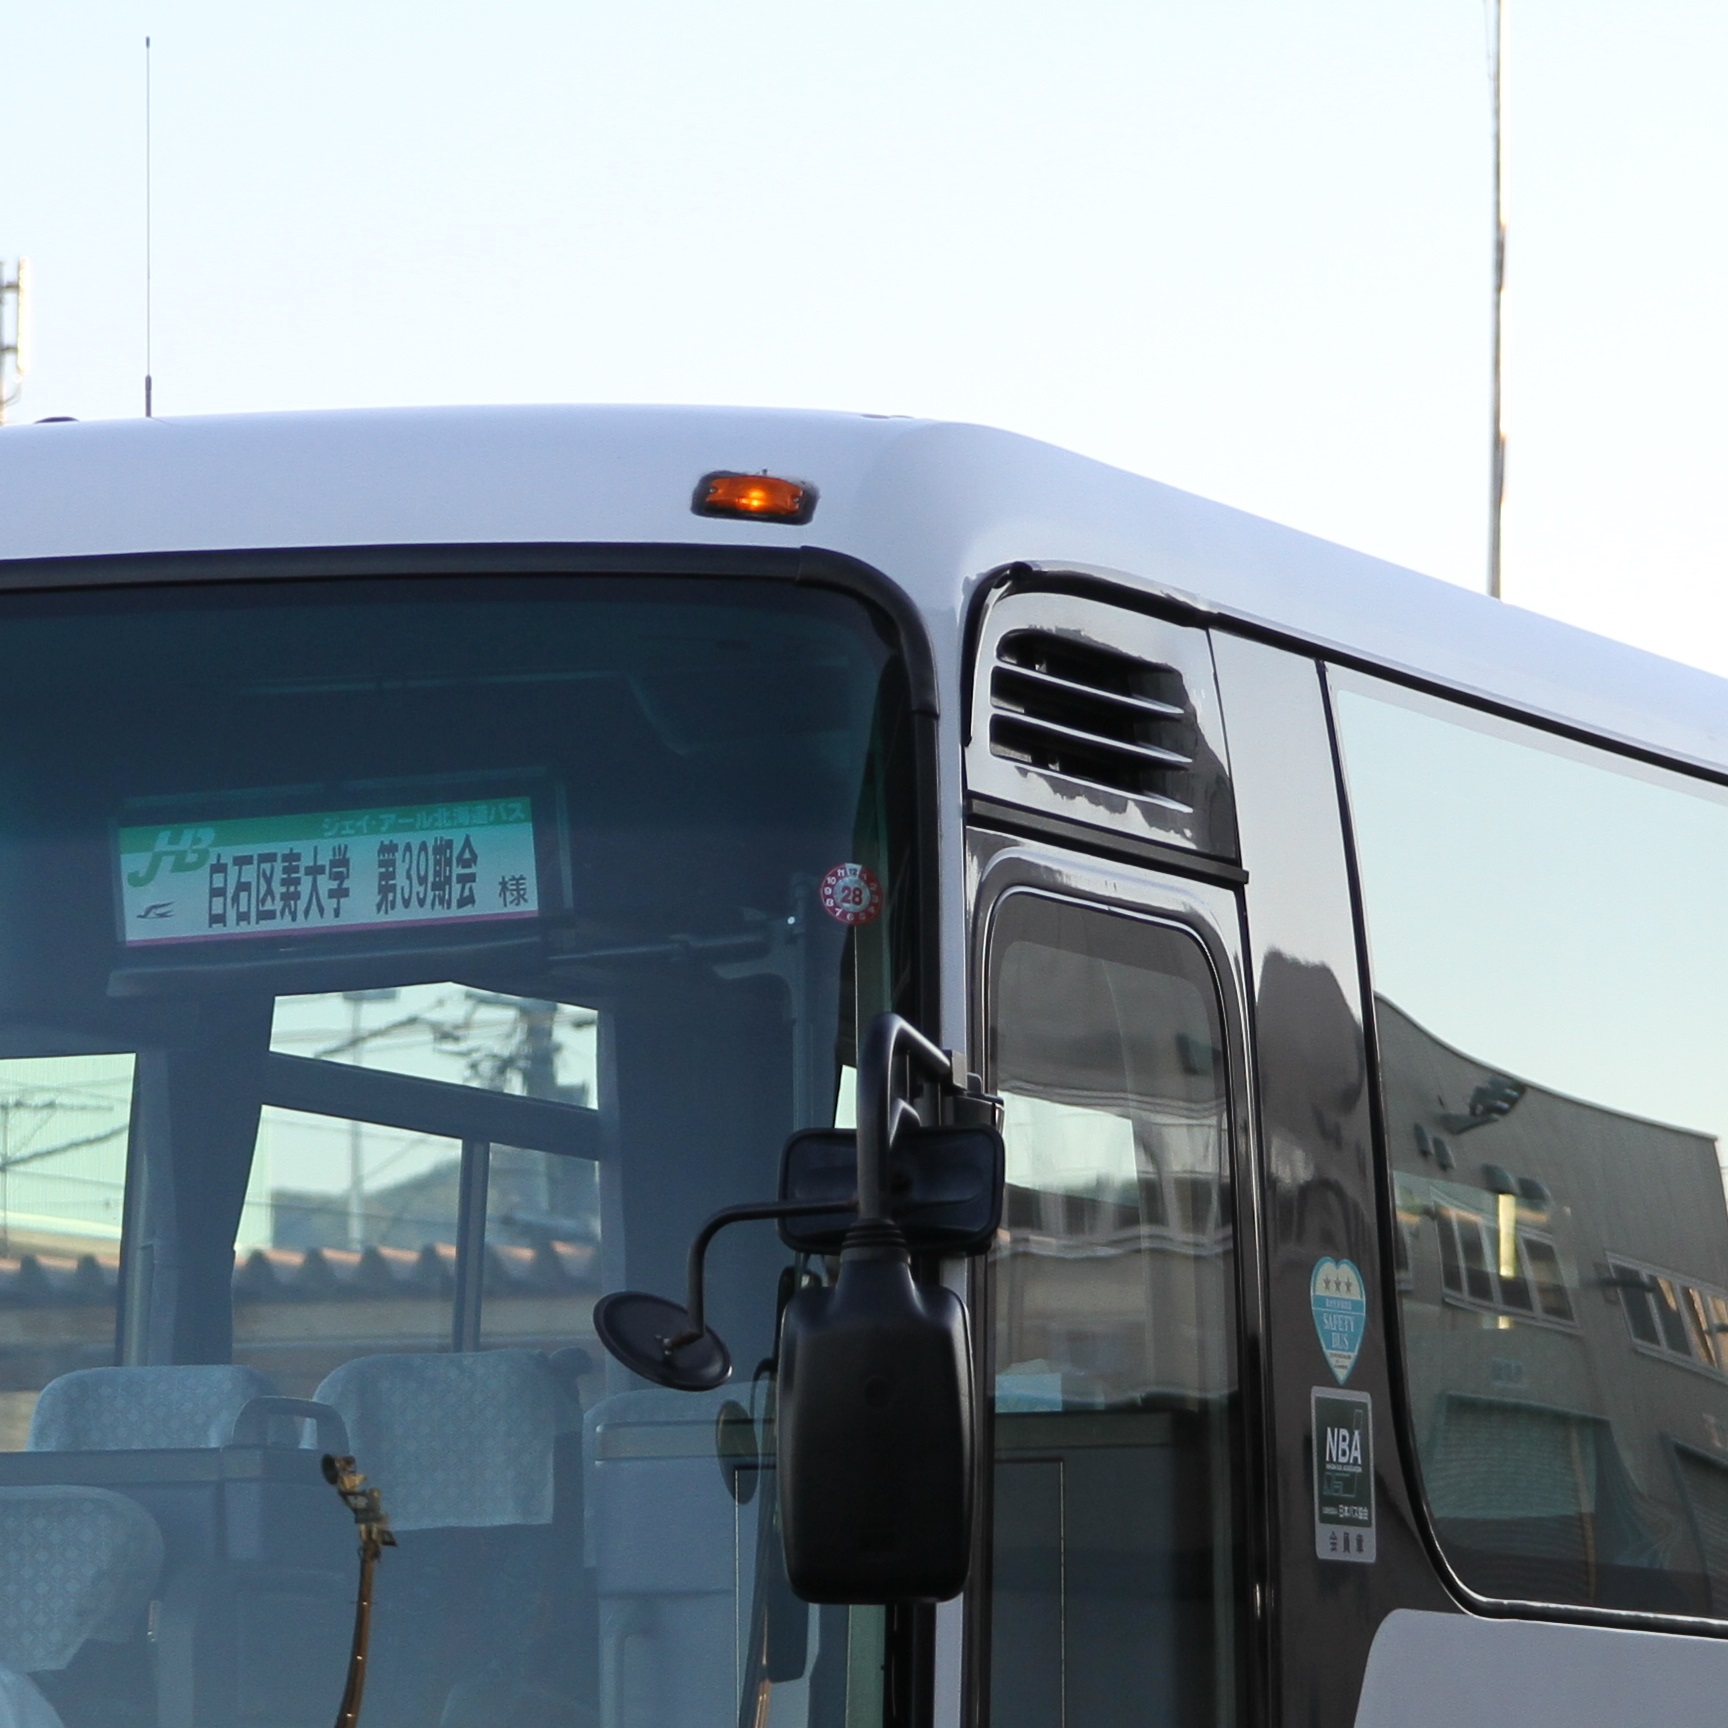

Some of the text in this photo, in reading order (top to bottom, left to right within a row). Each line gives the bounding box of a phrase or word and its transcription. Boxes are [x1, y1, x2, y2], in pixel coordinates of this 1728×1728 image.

[321, 802, 526, 838] ジェイ・アール北海道バス
[208, 833, 529, 928] 白石区寿大学 第39期会 様
[840, 886, 863, 906] 28
[1323, 1312, 1354, 1333] SAFETY
[1332, 1332, 1349, 1350] BUS
[1326, 1426, 1362, 1465] NBA
